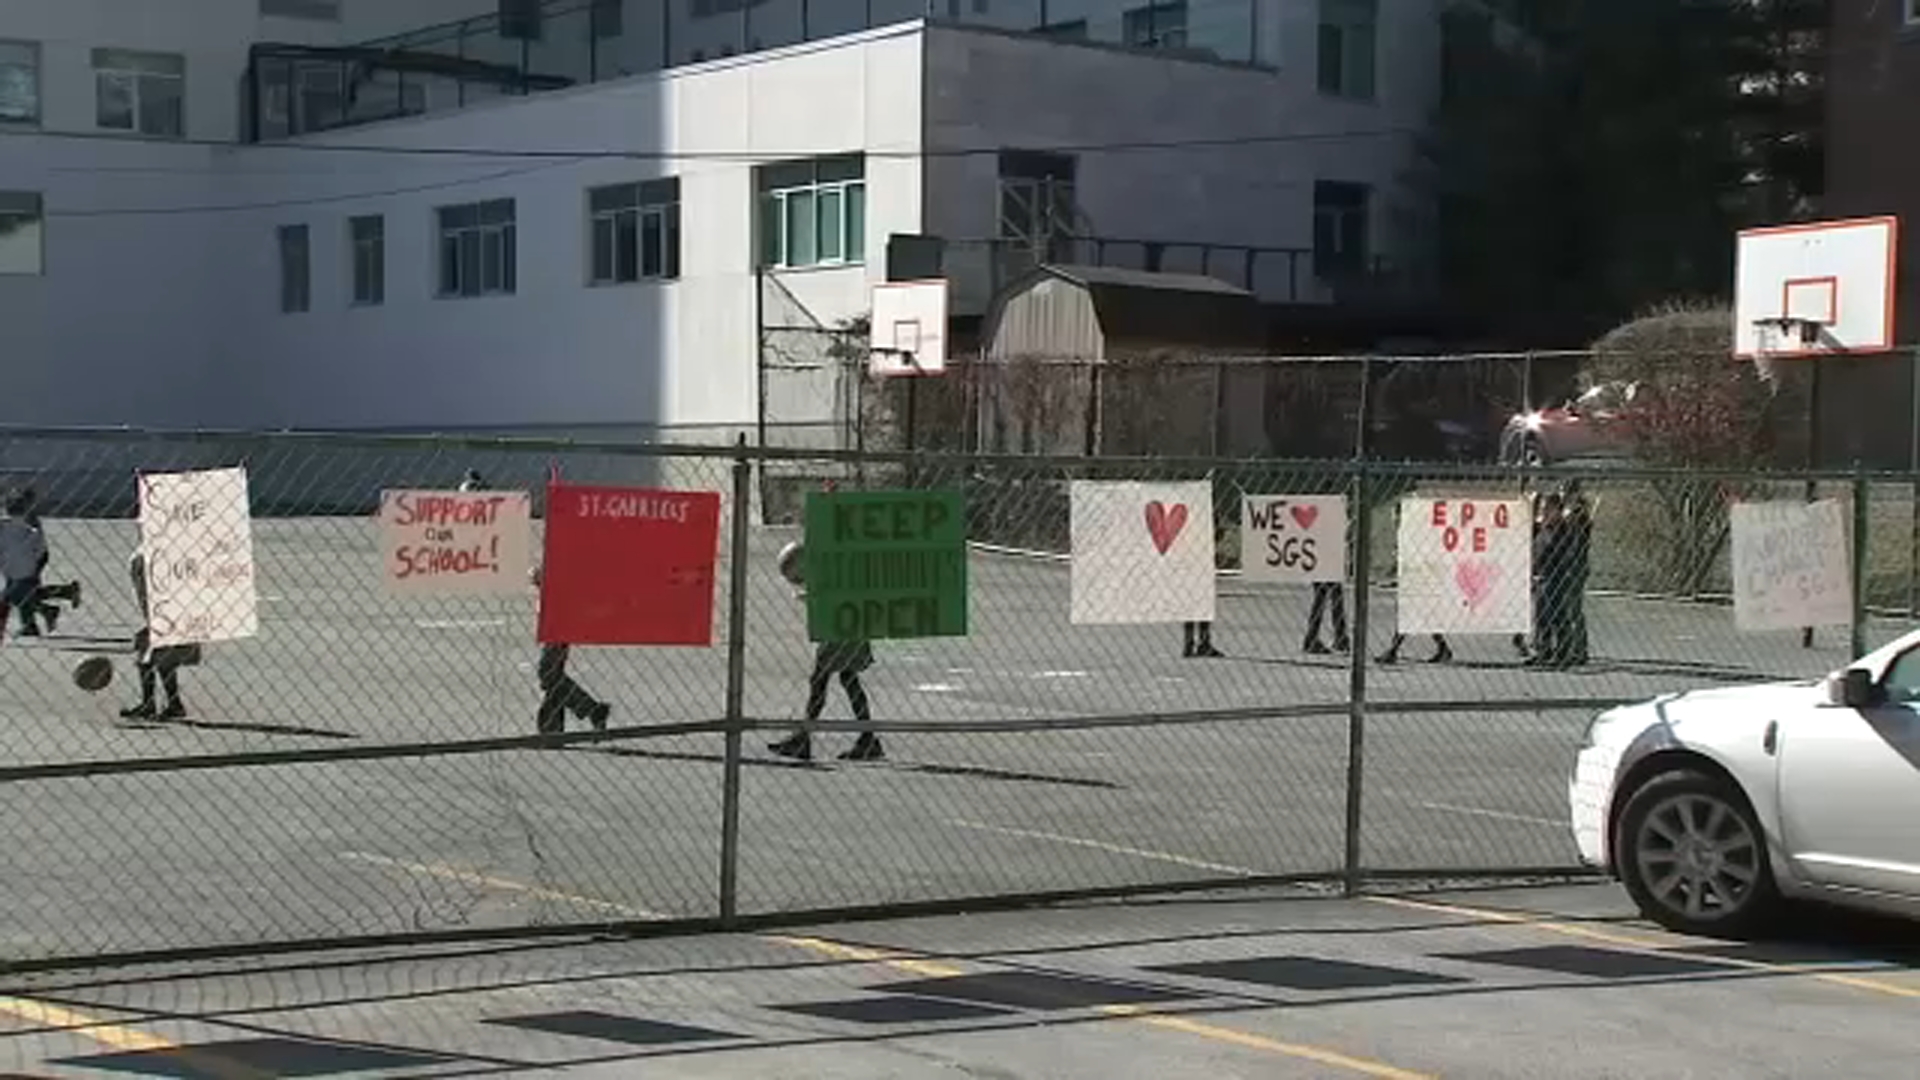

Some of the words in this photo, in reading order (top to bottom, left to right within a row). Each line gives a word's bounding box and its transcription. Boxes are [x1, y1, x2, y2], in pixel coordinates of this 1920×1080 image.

[395, 494, 505, 525] SUPPORT
[834, 501, 948, 541] KEEP
[1247, 501, 1286, 529] WE
[425, 527, 453, 541] OUR
[1266, 533, 1318, 571] SGS
[395, 536, 498, 579] SCHOOL!
[835, 598, 938, 638] OPEN
